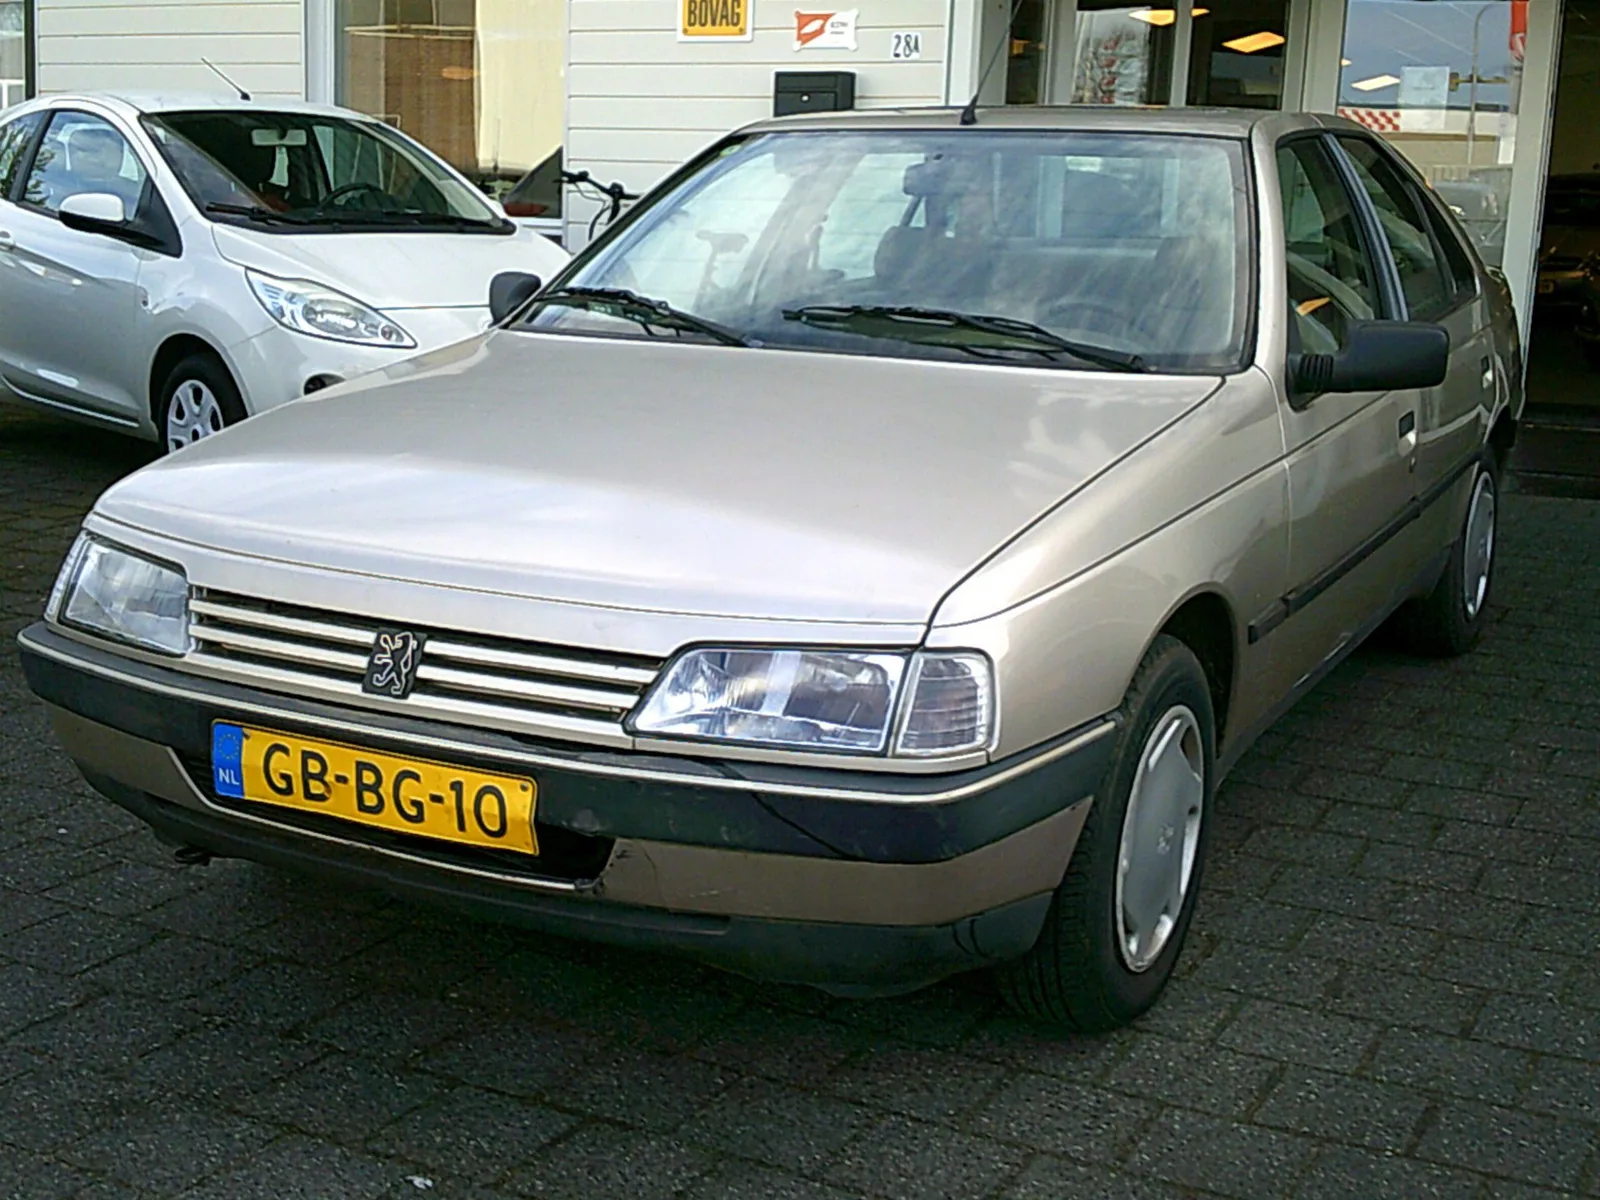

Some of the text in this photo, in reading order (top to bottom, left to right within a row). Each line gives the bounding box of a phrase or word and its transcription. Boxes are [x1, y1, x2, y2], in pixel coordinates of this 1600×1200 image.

[687, 0, 741, 27] BOVAG
[218, 767, 240, 786] NL
[262, 743, 508, 839] GB-BG-10
